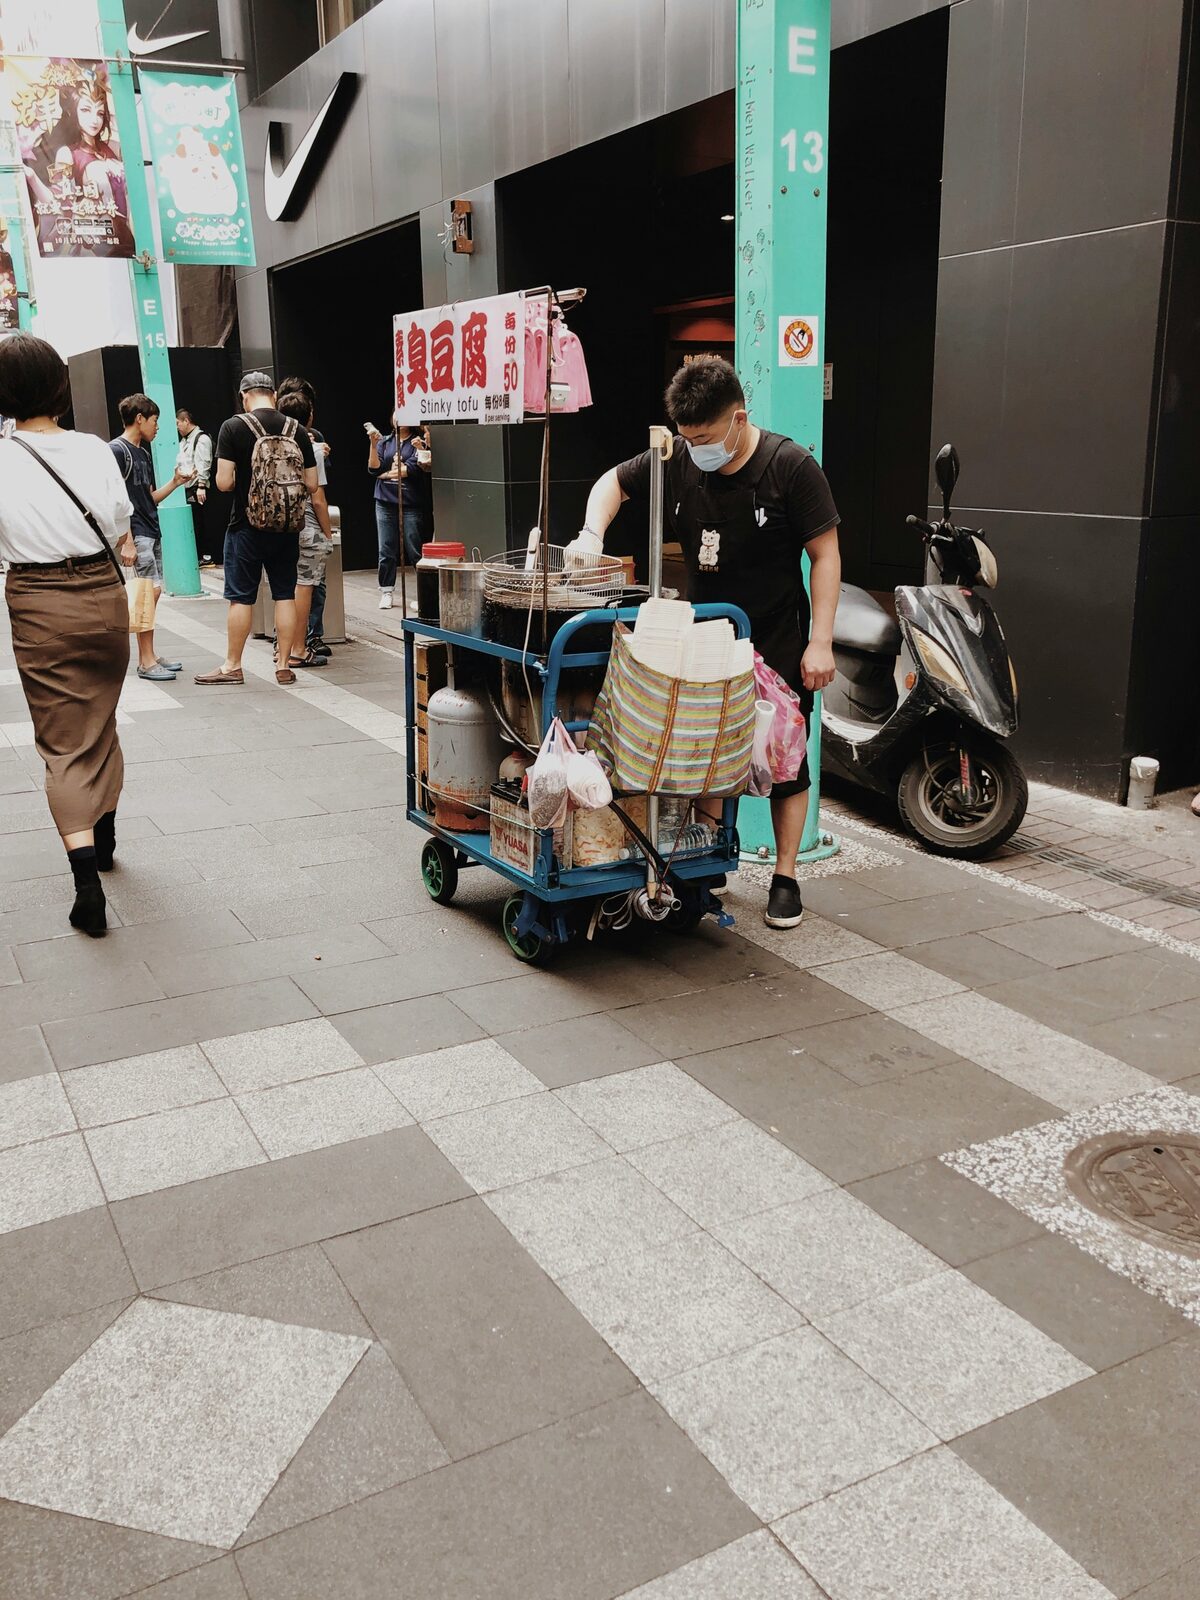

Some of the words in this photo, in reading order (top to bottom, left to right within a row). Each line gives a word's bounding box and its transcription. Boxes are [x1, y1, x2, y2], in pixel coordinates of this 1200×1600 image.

[788, 26, 816, 75] E
[780, 129, 823, 173] 13
[744, 143, 755, 210] Walker
[143, 299, 157, 315] E
[145, 332, 165, 348] 15
[407, 311, 487, 394] 臭豆腐
[420, 399, 452, 416] Stinky
[457, 396, 479, 412] tofu
[503, 833, 528, 856] YUASA
